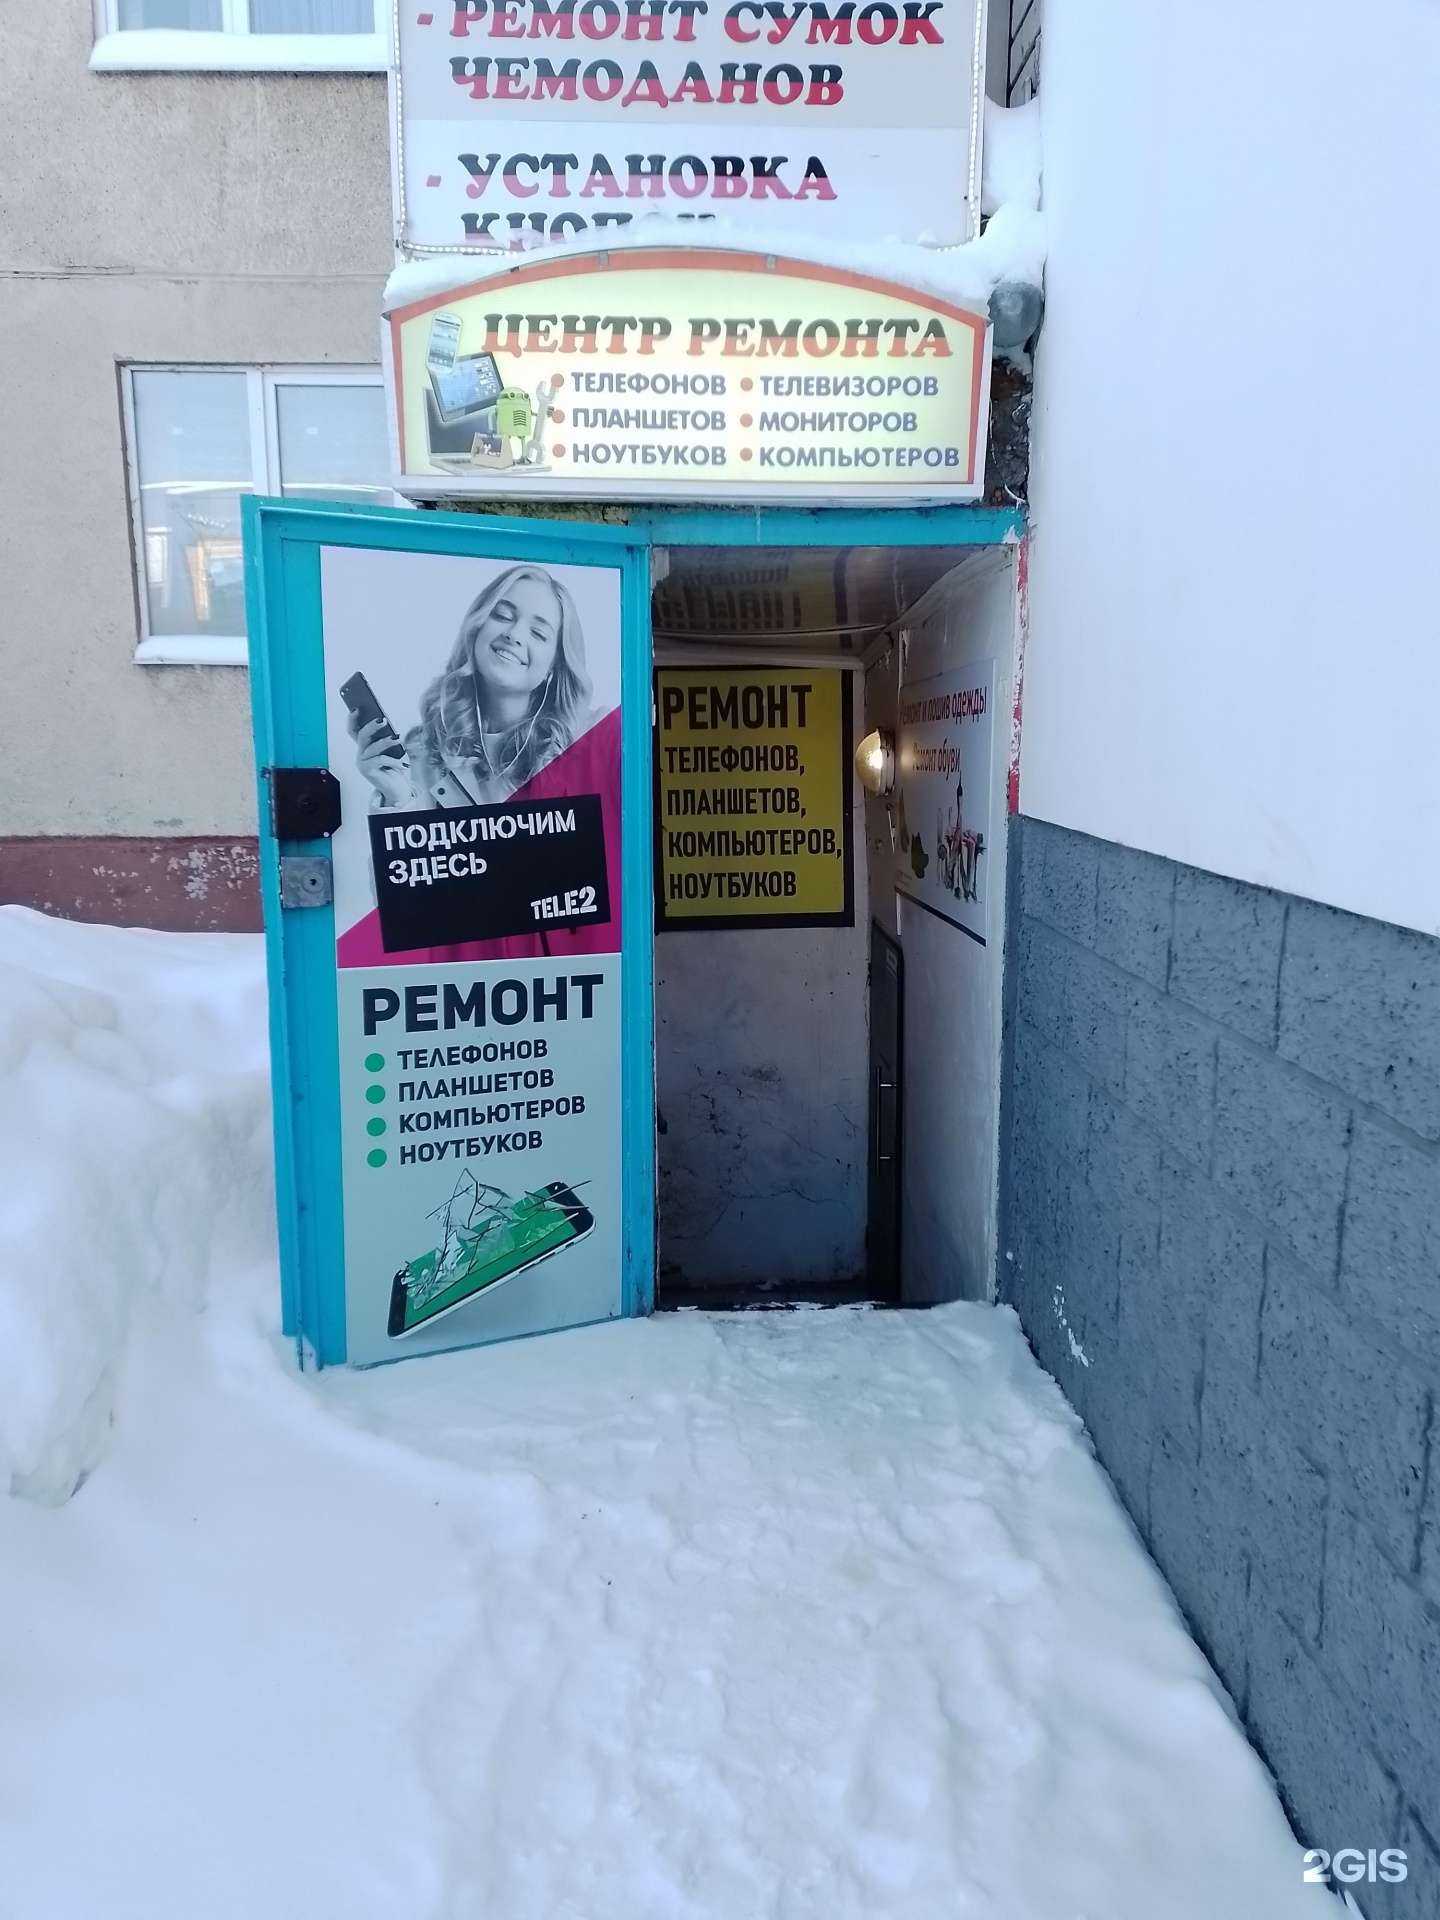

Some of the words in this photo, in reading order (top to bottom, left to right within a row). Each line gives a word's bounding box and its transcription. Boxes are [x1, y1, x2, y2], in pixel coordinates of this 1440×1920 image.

[449, 0, 709, 42] РЕМОНТ
[724, 2, 945, 45] СУМОК
[449, 56, 845, 107] ЧЕМОДАНОВ
[458, 153, 838, 201] УСТАНОВКА
[480, 313, 672, 359] ЦЕНТР
[686, 314, 953, 358] РЕМОНТА
[571, 371, 727, 396] ТЕЛЕФОНОВ
[760, 373, 940, 398] ТЕЛЕВИЗОРОВ
[572, 407, 728, 432] ПЛАНШЕТОВ
[759, 411, 918, 433] МОНИТОРОВ
[572, 442, 727, 467] НОУТБУКОВ
[759, 446, 960, 468] КОМПЬЮТЕРОВ
[662, 683, 812, 730] РЕМОНТ
[952, 685, 987, 725] одежды
[664, 744, 805, 776] ТЕЛЕФОНОВ,
[938, 738, 961, 781] обуви
[667, 787, 807, 818] ПЛАНШЕТОВ,
[384, 809, 576, 852] ПОДКЛЮЧИМ
[668, 827, 842, 860] КОМПЬЮТЕРОВ,
[388, 852, 488, 887] ЗДЕСЬ
[669, 870, 797, 900] НОУТБУКОВ
[530, 886, 598, 920] TELE2
[362, 974, 604, 1036] РЕМОНТ
[397, 1038, 549, 1070] ТЕЛЕФОНОВ
[398, 1068, 555, 1103] ПЛАНШЕТОВ
[399, 1095, 586, 1135] КОМПЬЮТЕРОВ
[400, 1130, 544, 1166] НОУТБУКОВ
